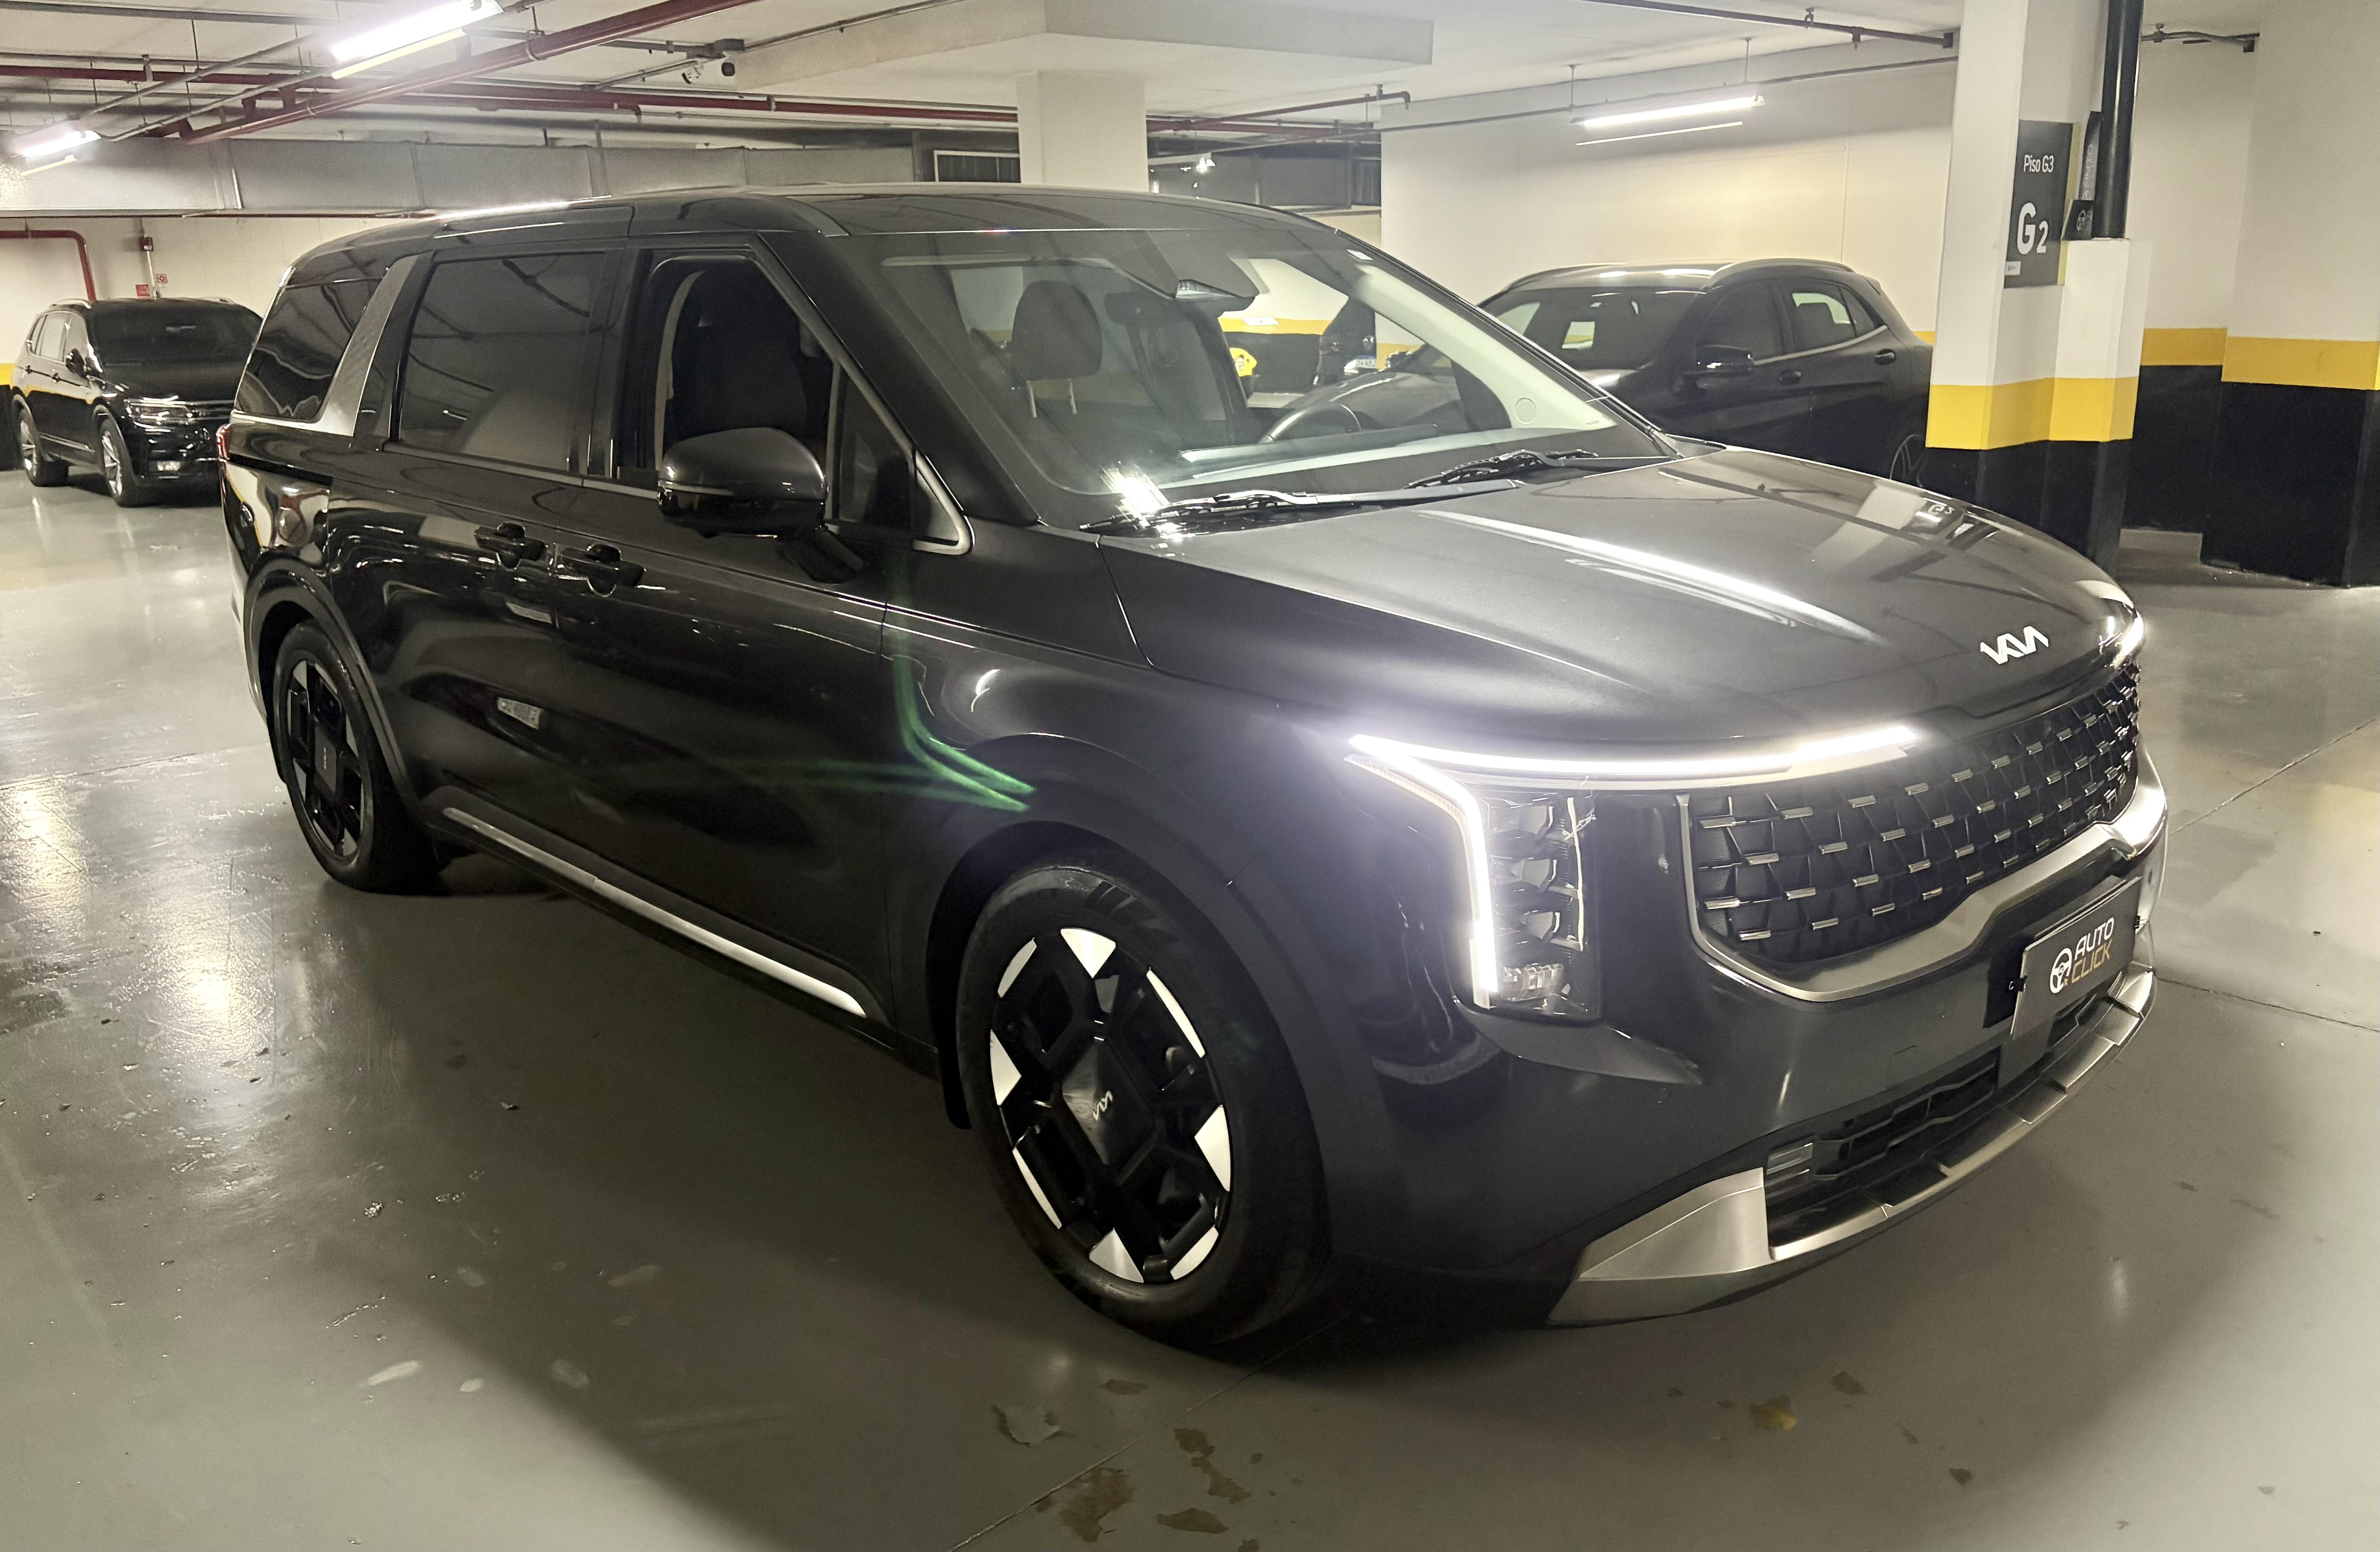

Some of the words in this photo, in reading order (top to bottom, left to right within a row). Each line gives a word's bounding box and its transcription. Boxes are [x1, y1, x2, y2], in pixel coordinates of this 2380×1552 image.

[2023, 155, 2041, 172] Piso
[2042, 155, 2055, 173] G3
[1980, 626, 2049, 665] KIA
[2074, 917, 2115, 961] AUTO
[2071, 939, 2113, 984] CLICK
